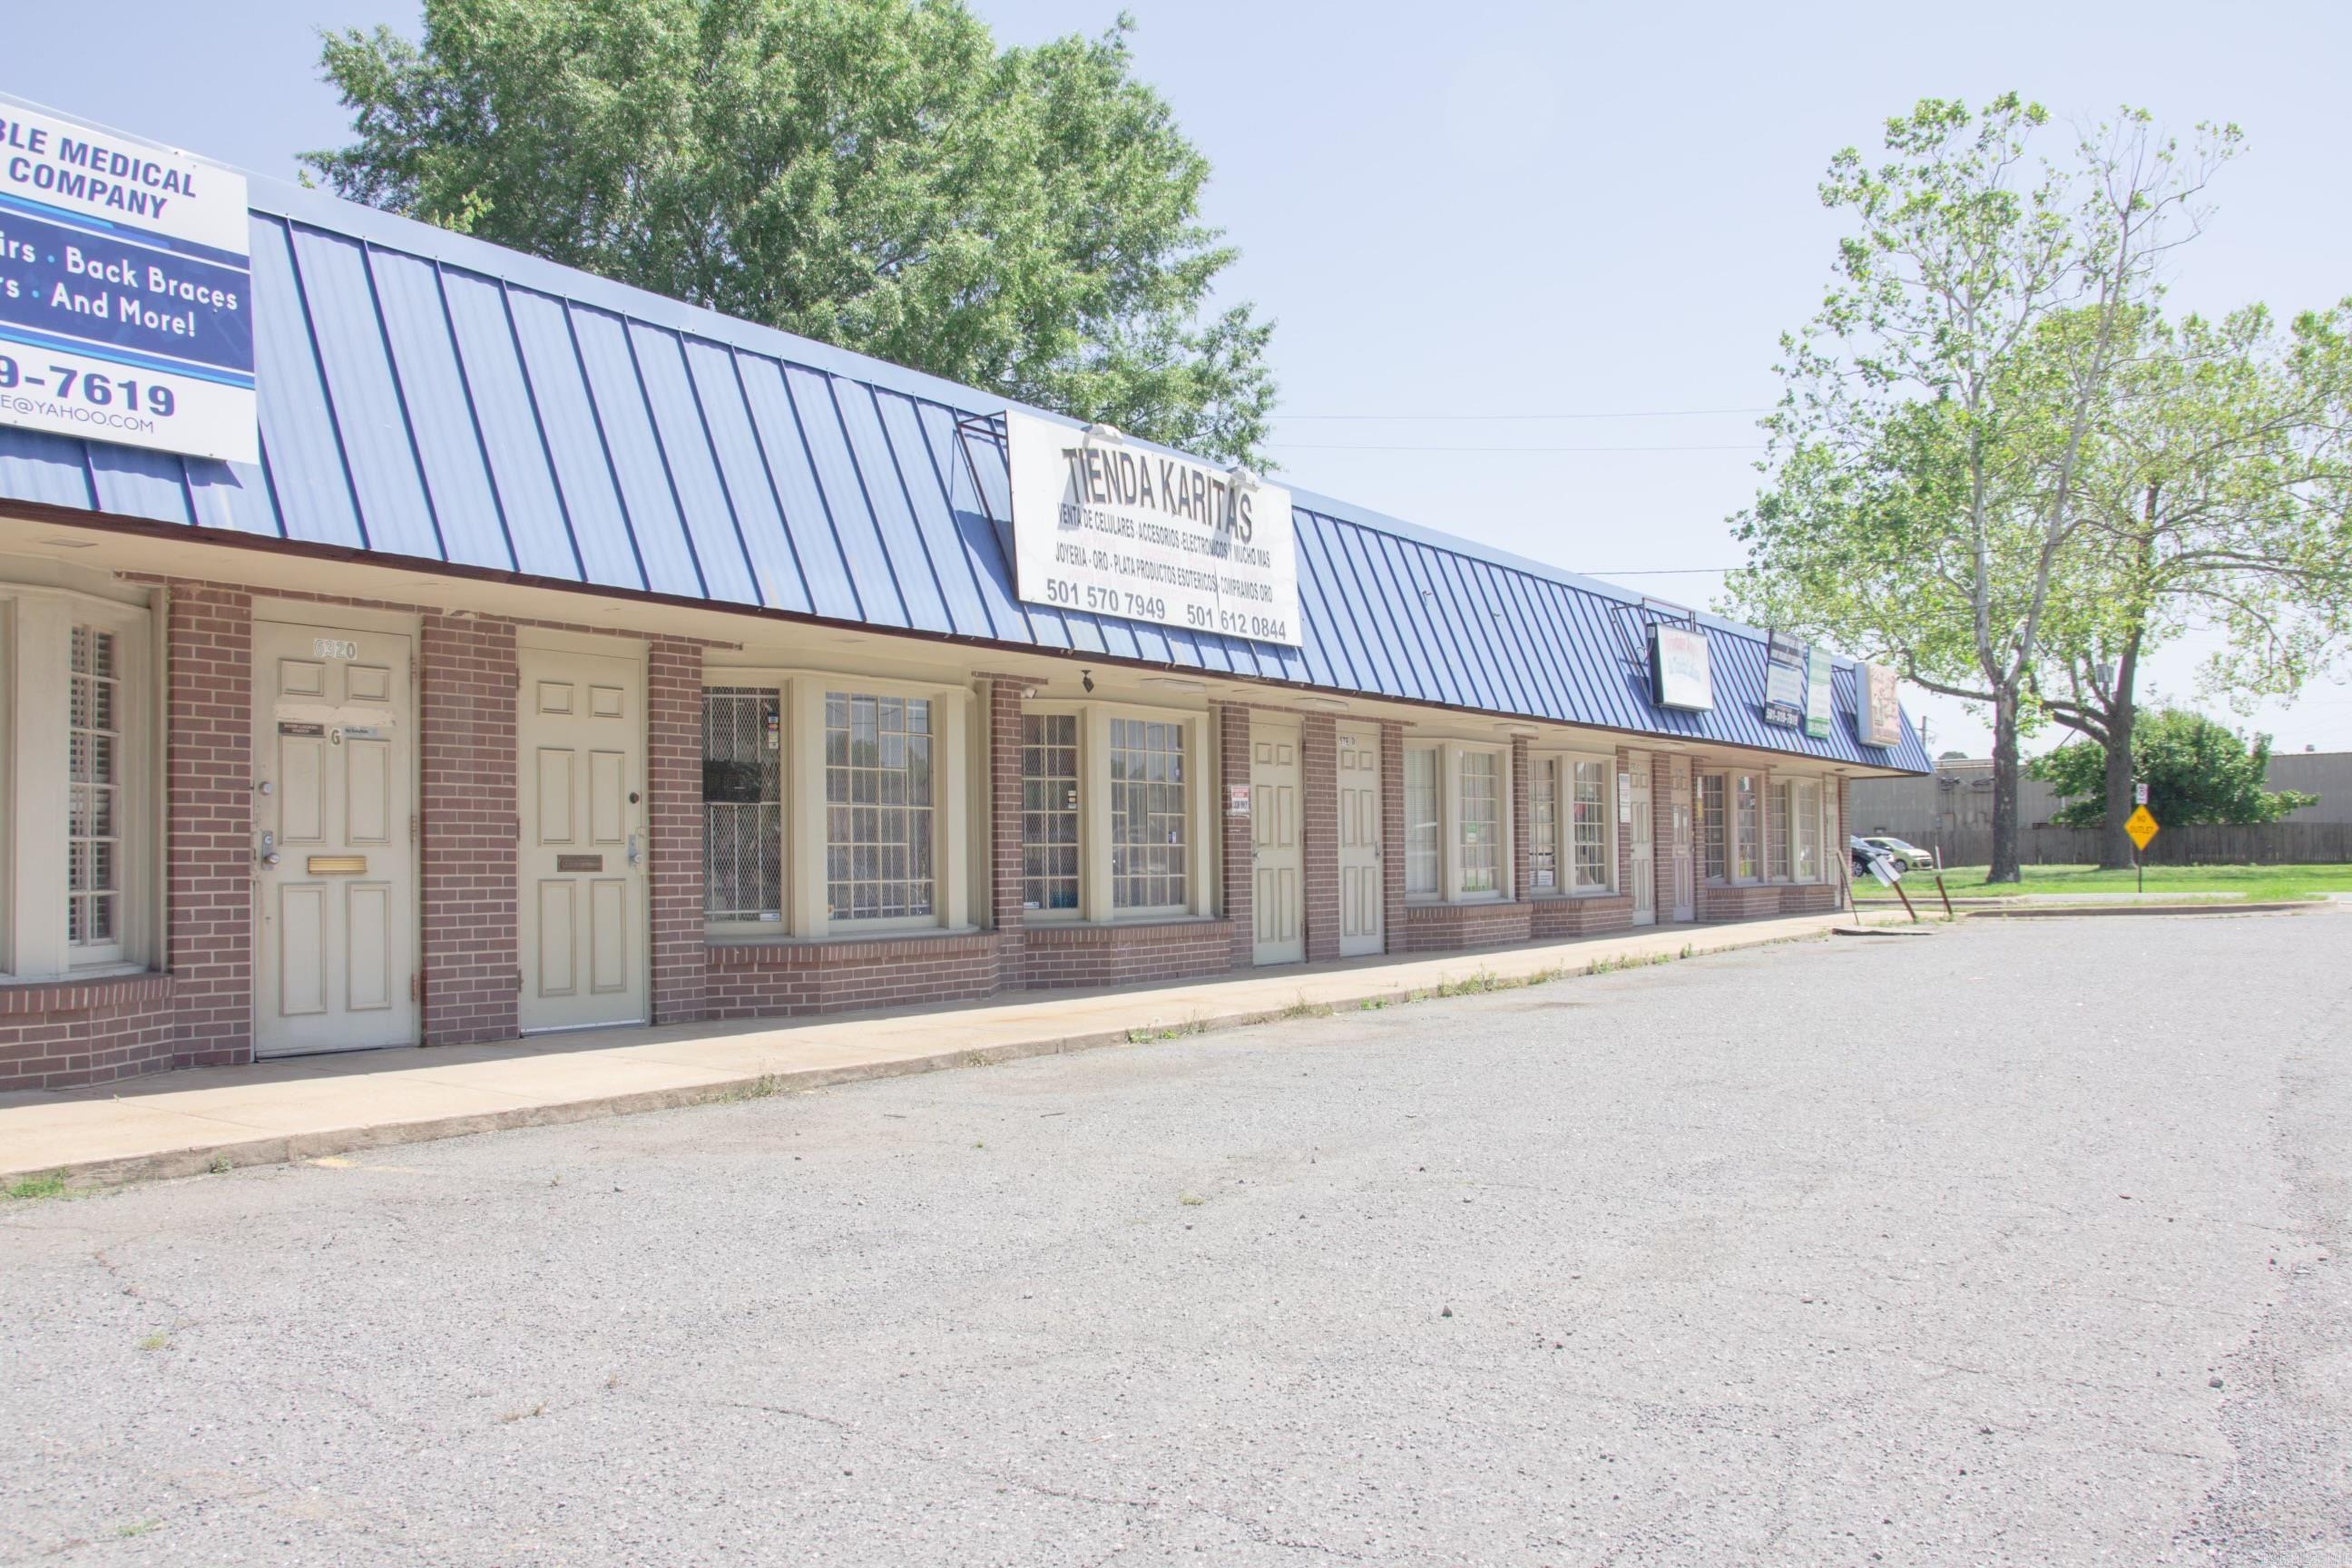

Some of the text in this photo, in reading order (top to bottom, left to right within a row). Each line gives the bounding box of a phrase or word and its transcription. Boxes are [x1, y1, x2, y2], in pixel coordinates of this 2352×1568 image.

[9, 156, 168, 220] COMPANY
[59, 137, 197, 199] MEDICAL
[65, 246, 139, 288] Back
[148, 265, 238, 310] Braces
[51, 281, 108, 319] And
[120, 297, 196, 337] More!
[0, 355, 174, 417] 9-7619
[1, 394, 153, 434] E@YAHOO.COM
[1062, 447, 1253, 544] TIENDA KARITAS
[1057, 502, 1082, 526] VENTA
[1083, 508, 1093, 529] DE
[1094, 511, 1134, 539] CELULARES
[1139, 522, 1180, 549] ACCESORIOS
[1234, 544, 1256, 566] MUCHO
[1258, 549, 1270, 568] MAS
[1047, 578, 1165, 620] 501 570 7949
[1055, 542, 1273, 603] JOYERIA ORO PLATA PRODUCTOS ESOTERICOS COMPRAMOS ORO
[1187, 603, 1287, 640] 501 612 0844
[330, 729, 341, 746] G
